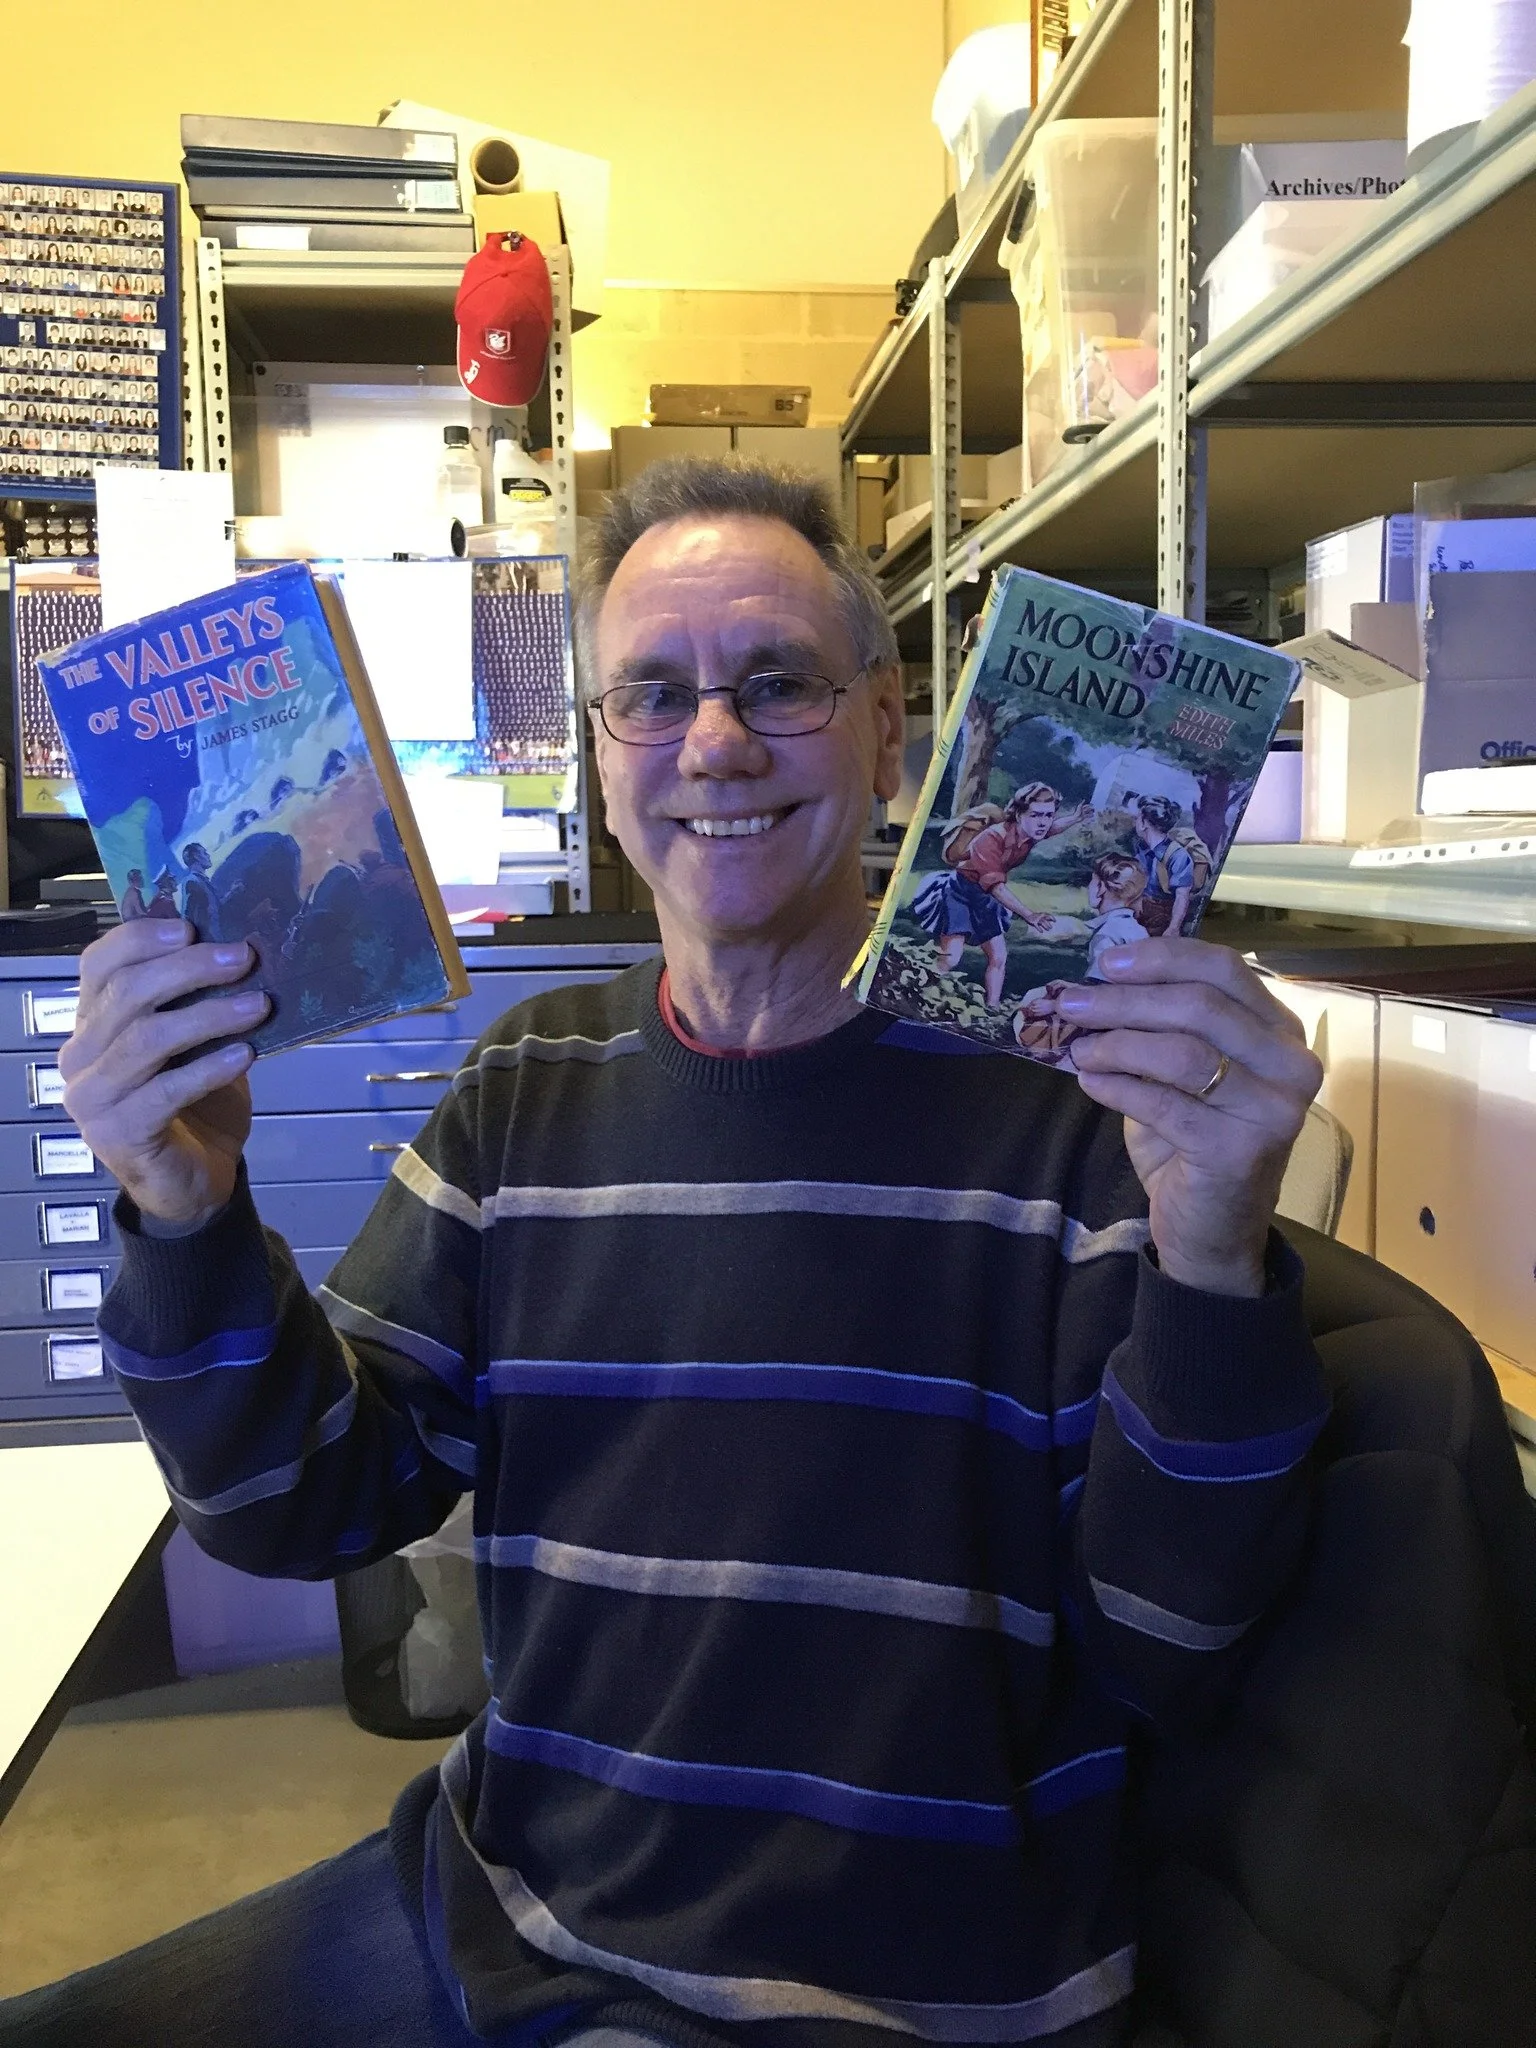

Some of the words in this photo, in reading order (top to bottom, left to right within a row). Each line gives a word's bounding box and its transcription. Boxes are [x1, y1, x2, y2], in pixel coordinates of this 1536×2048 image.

[58, 657, 102, 689] THE
[104, 596, 284, 689] VALLEYS
[1015, 599, 1270, 712] MOONSHINE
[88, 706, 120, 735] OF
[128, 645, 302, 740] SILENCE
[1000, 645, 1146, 719] ISLAND
[1178, 704, 1236, 733] EDITH
[165, 735, 193, 758] by
[200, 722, 248, 750] JAMES
[252, 706, 300, 733] STAGG
[1170, 720, 1228, 750] MILES
